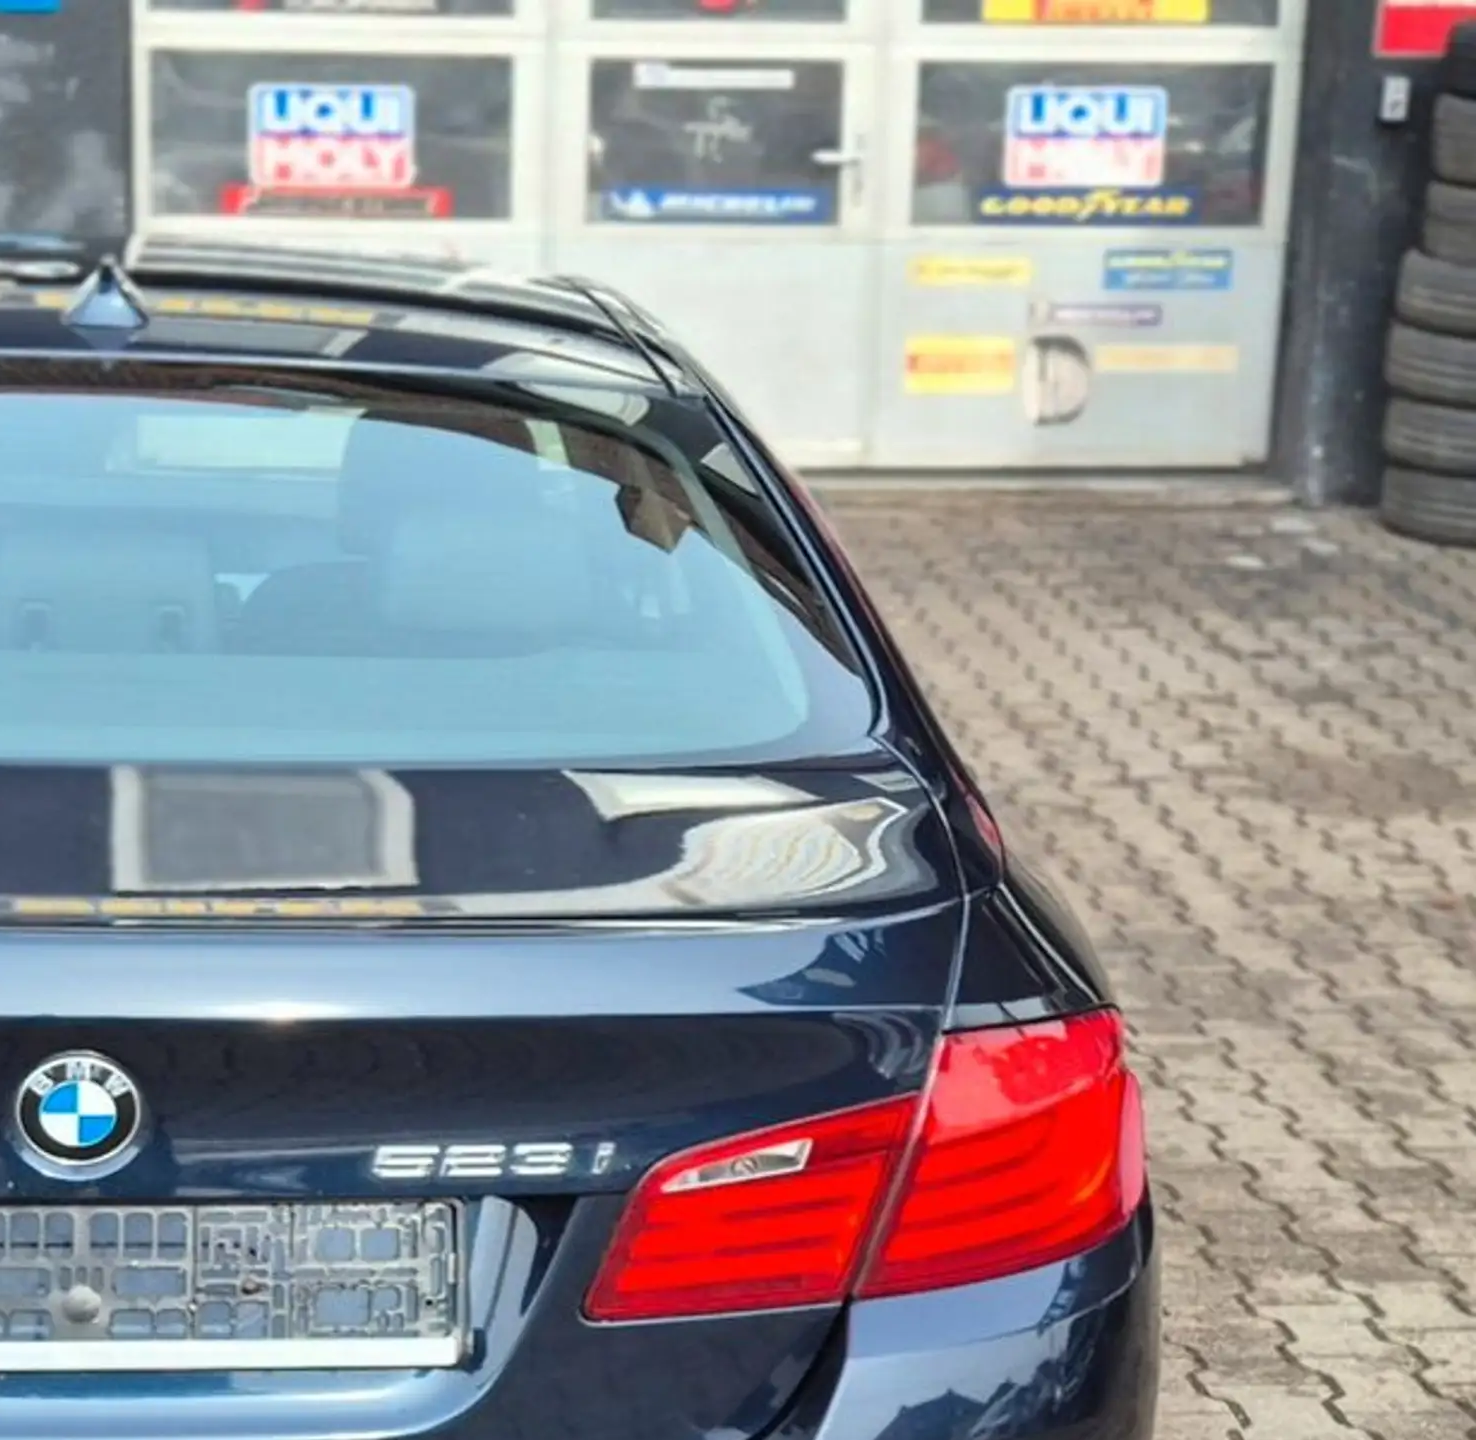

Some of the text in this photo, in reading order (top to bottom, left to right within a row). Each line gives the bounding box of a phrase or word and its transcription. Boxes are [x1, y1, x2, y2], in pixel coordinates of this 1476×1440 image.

[263, 89, 401, 135] LIQUI
[1019, 91, 1156, 136] LIQUI
[264, 136, 404, 184] MOLY
[1016, 137, 1158, 184] MOLY
[981, 188, 1192, 223] GOODYEAR
[26, 1060, 132, 1098] BMW
